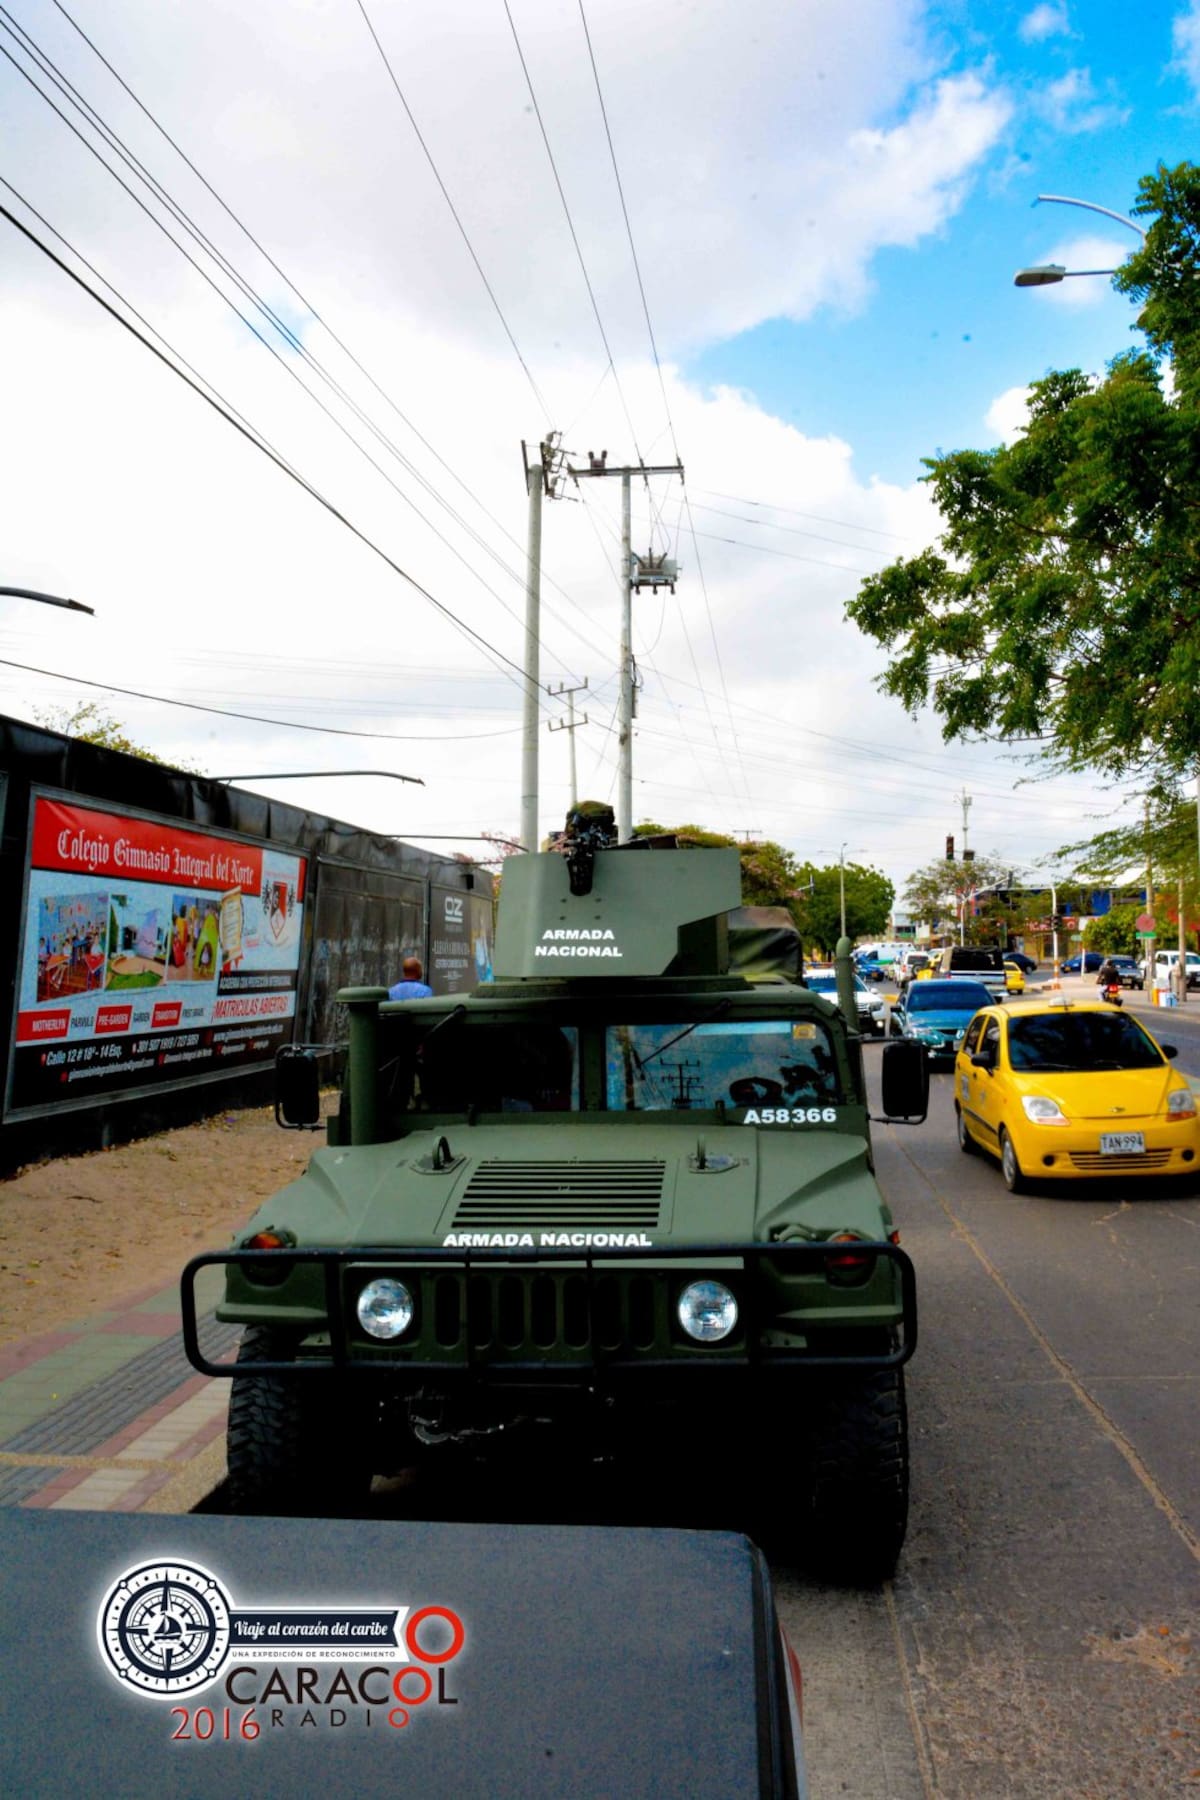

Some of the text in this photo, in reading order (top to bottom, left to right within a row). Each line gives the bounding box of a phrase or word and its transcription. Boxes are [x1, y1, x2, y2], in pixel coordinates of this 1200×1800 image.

[57, 828, 254, 885] Colegio Gimnasio Integral del Norte
[542, 929, 615, 940] ARMADA
[535, 945, 623, 957] NACIONAL
[743, 1107, 837, 1124] A58366
[442, 1233, 652, 1247] ARMADA NACIONAL
